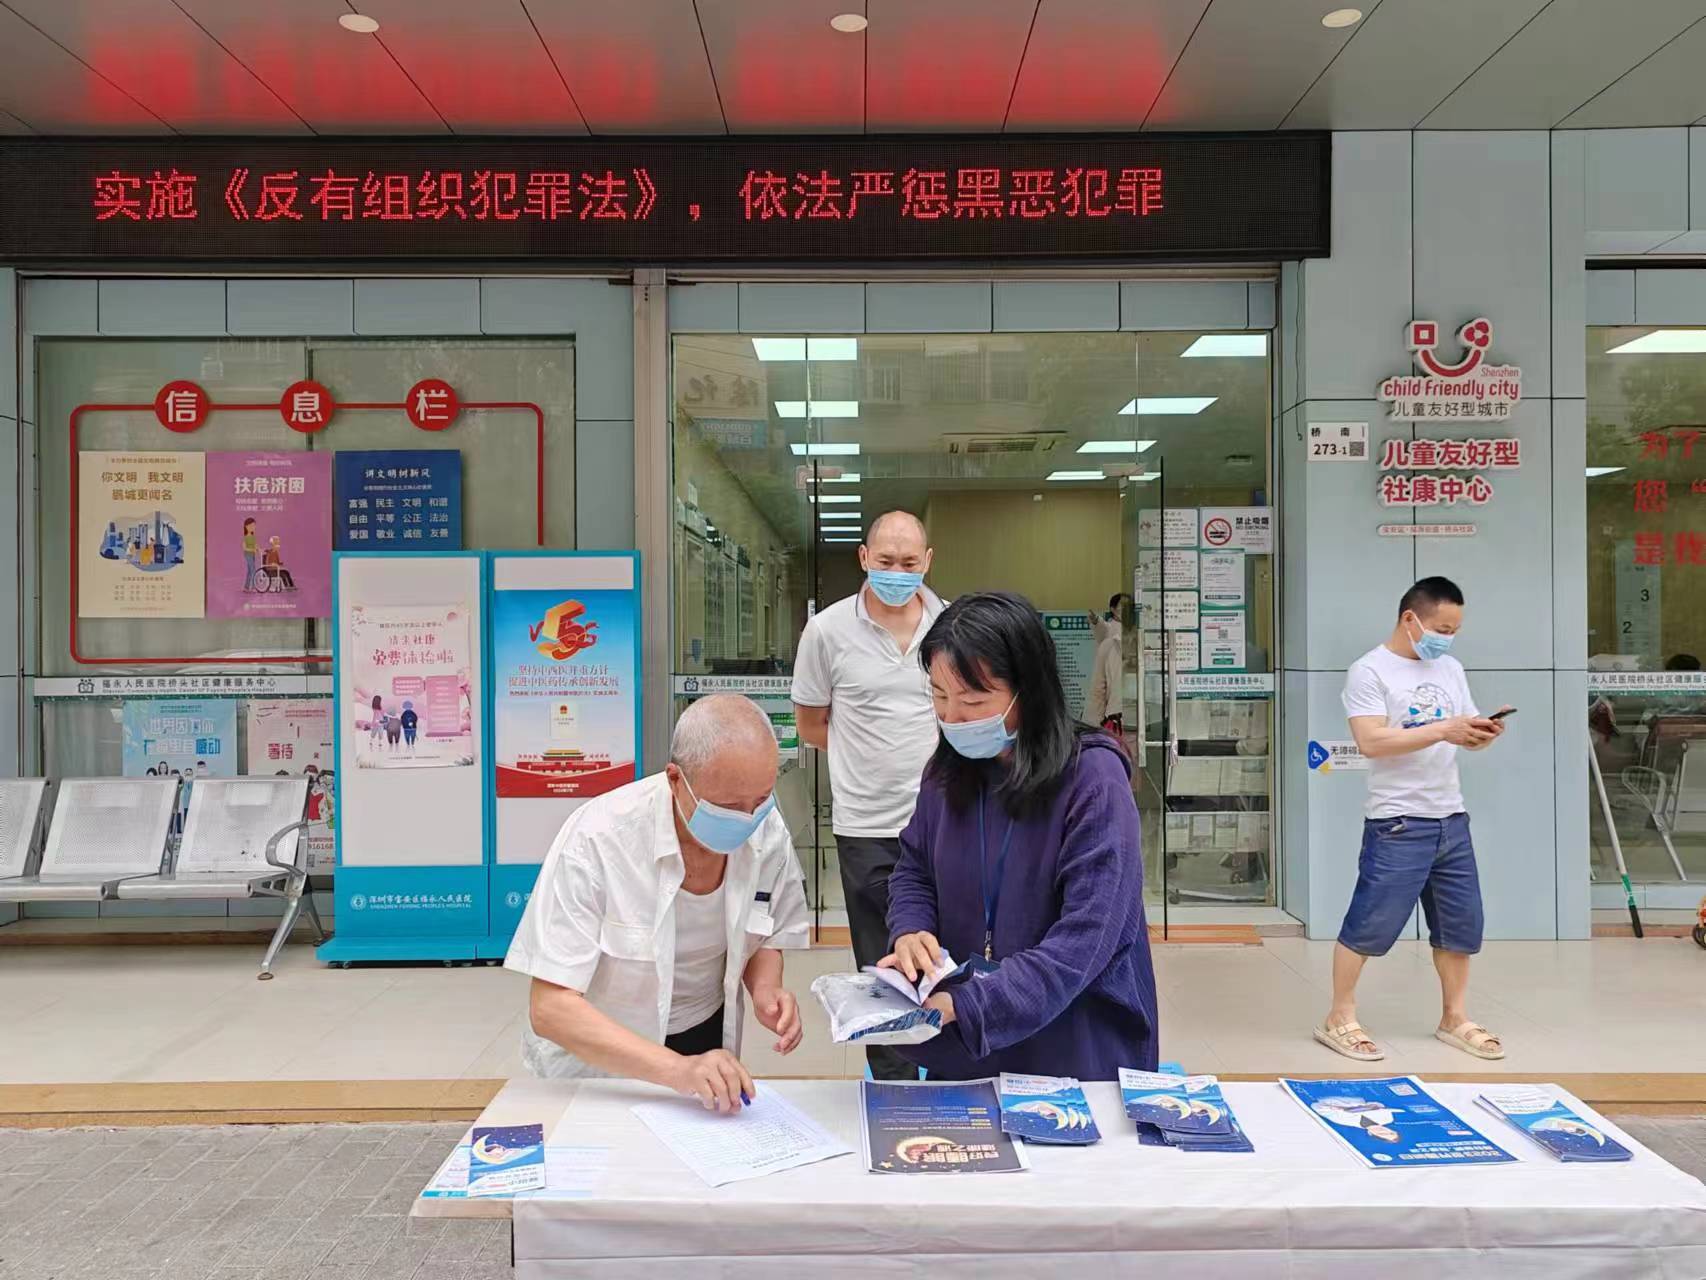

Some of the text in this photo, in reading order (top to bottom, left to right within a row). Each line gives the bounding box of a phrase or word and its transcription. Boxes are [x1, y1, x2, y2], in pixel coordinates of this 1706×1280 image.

[1481, 367, 1519, 377] Shenzhen
[1385, 380, 1421, 397] child
[1489, 380, 1519, 400] city
[1394, 401, 1508, 417] 儿童友好型城市
[1313, 443, 1348, 456] 273-1
[1383, 440, 1520, 467] 儿童友好型
[102, 472, 184, 483] 你文明 我文明
[365, 468, 431, 478] 讲文明树新风
[234, 477, 305, 494] 扶危济困
[1383, 476, 1492, 503] 社康中心
[112, 489, 172, 501] 鹏城更闻名
[349, 497, 448, 508] 富强 民主 文明 和谐
[349, 513, 448, 524] 自由 平等 公正 法治
[1236, 517, 1270, 525] 禁止吸烟
[349, 528, 448, 539] 爱国 敬业 诚信 友善
[1640, 588, 1650, 602] 3
[1622, 621, 1633, 634] 2
[518, 664, 609, 676] 坚持中西医并重方针
[508, 676, 619, 687] 促进中医药传承创新发展
[1587, 674, 1706, 684] 永人民医院桥头社区健康服
[1330, 745, 1361, 756] 无障碍
